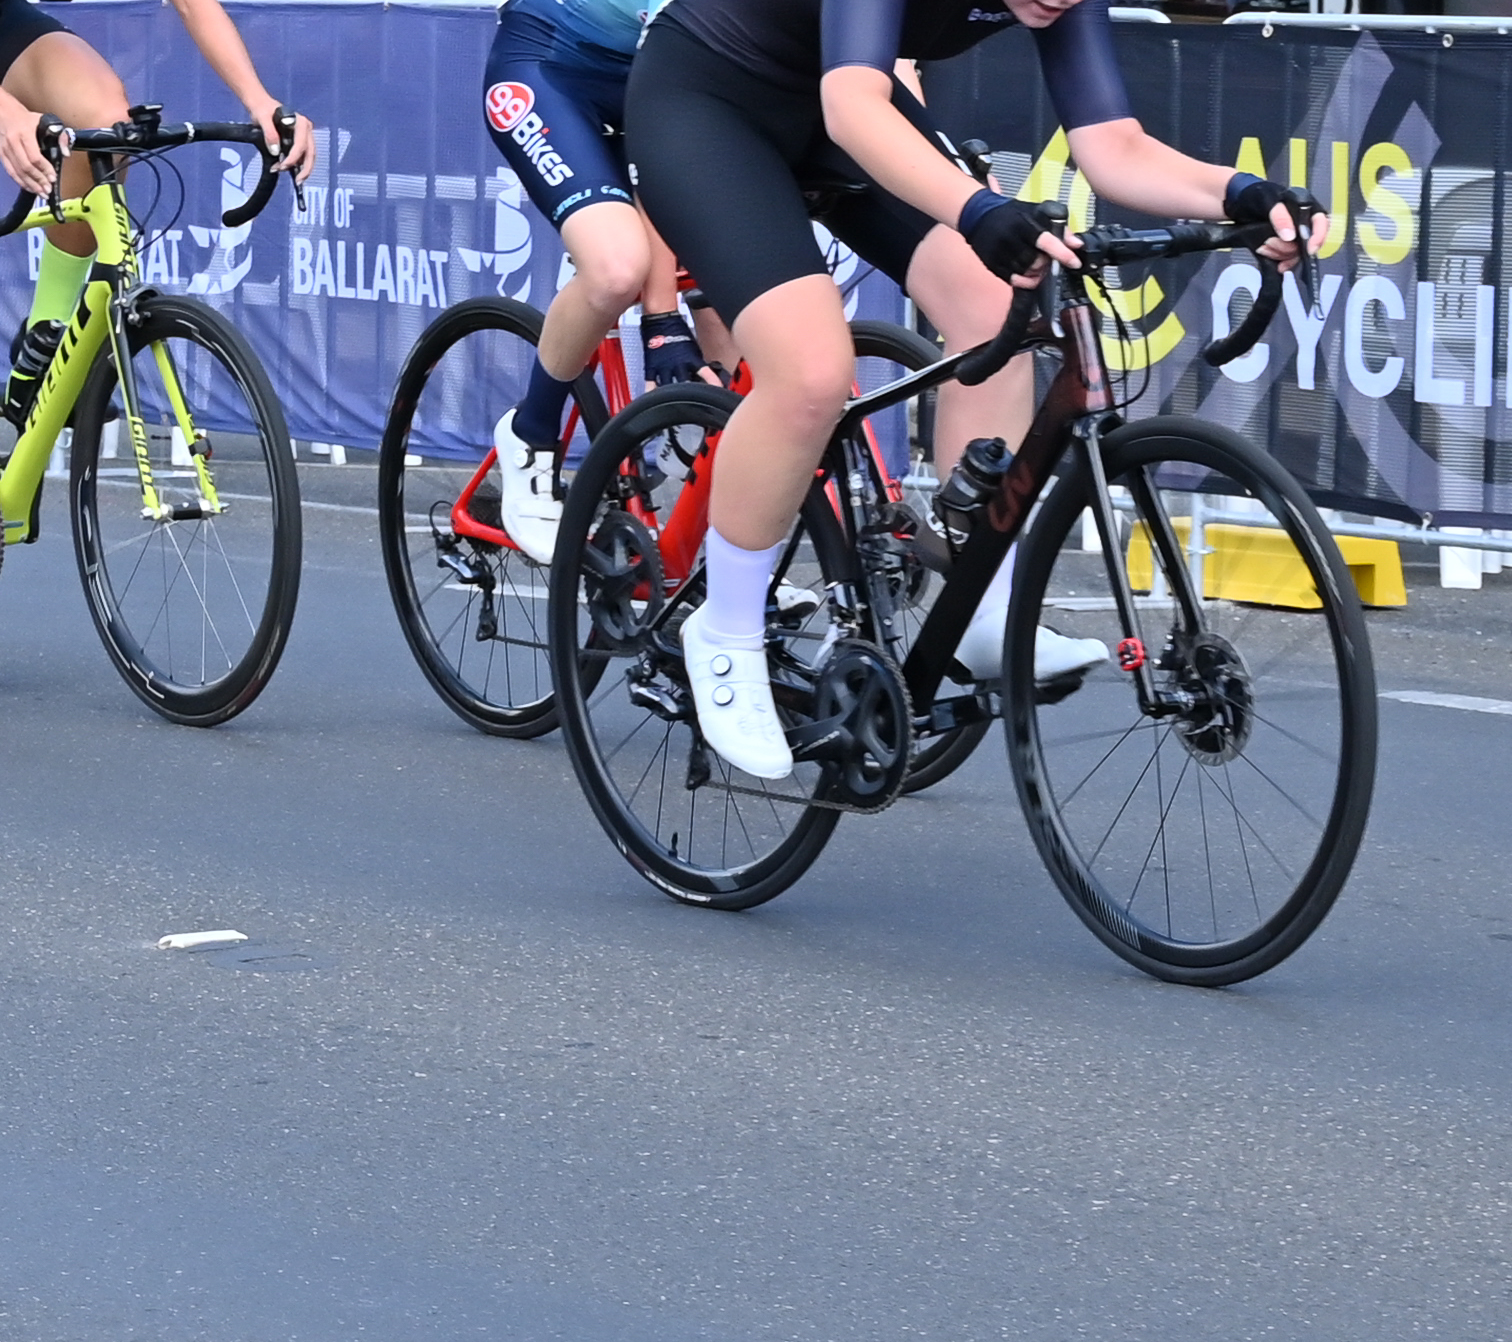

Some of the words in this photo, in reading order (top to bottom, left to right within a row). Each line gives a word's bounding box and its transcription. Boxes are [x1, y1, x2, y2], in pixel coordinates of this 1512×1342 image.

[488, 85, 527, 130] 99
[511, 112, 574, 187] BIKES
[293, 186, 328, 226] CITY
[334, 187, 354, 228] OF
[292, 237, 449, 309] BALLARAT
